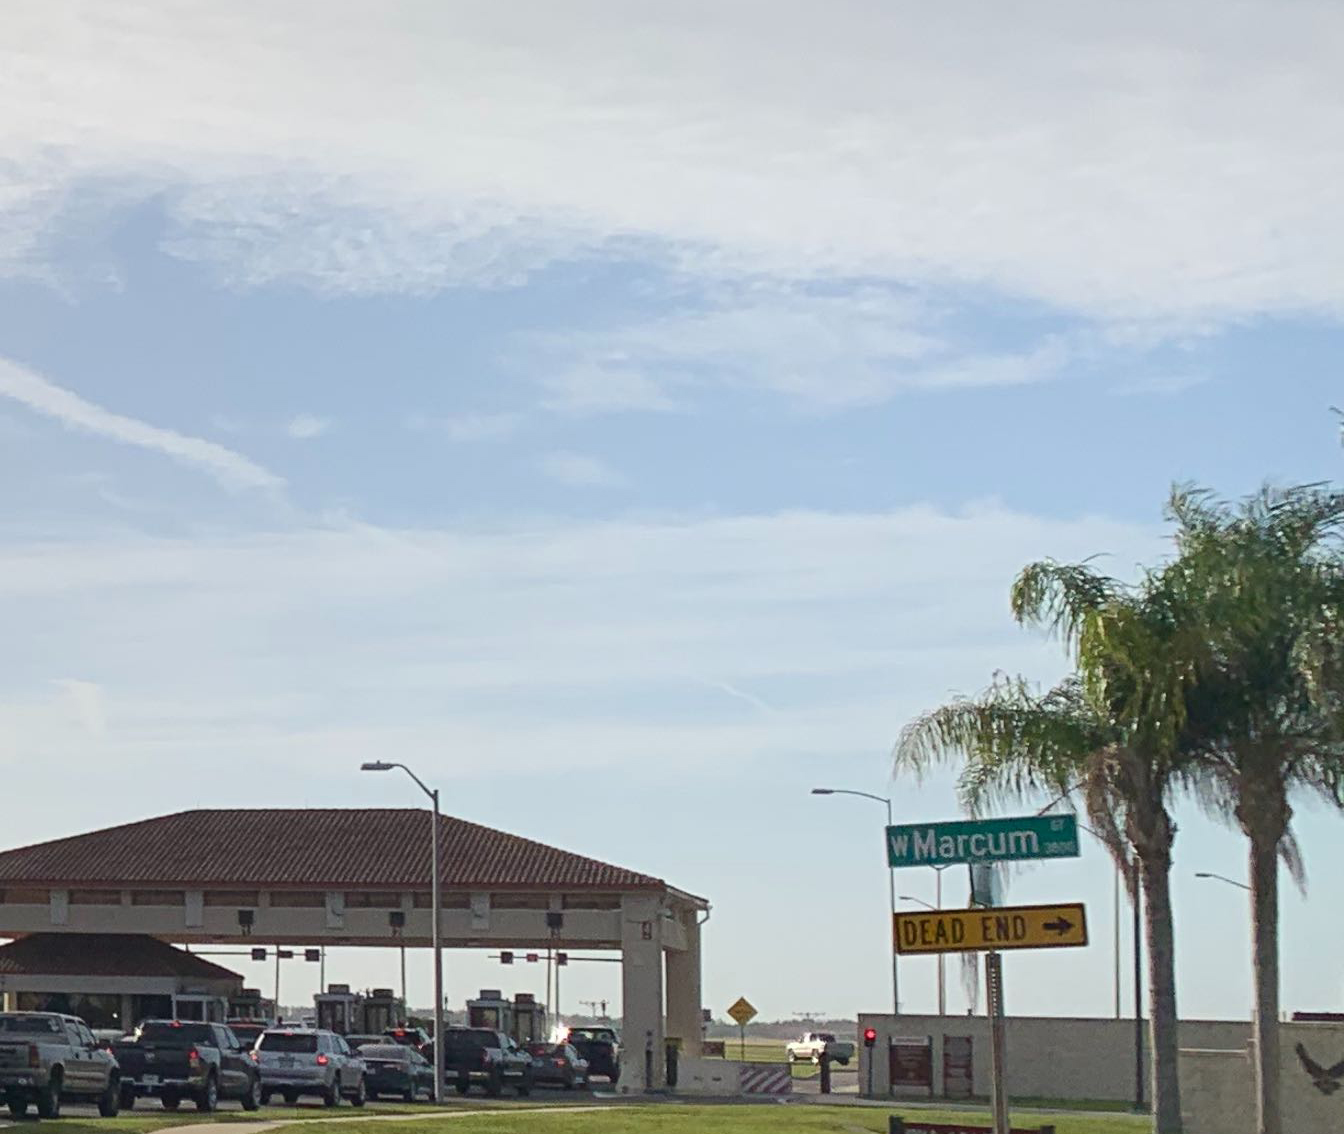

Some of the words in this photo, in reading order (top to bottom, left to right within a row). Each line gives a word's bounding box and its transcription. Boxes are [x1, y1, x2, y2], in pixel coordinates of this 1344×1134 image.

[891, 834, 909, 857] W
[912, 829, 1039, 860] Marcum
[903, 917, 965, 946] DEAD
[981, 915, 1026, 942] END
